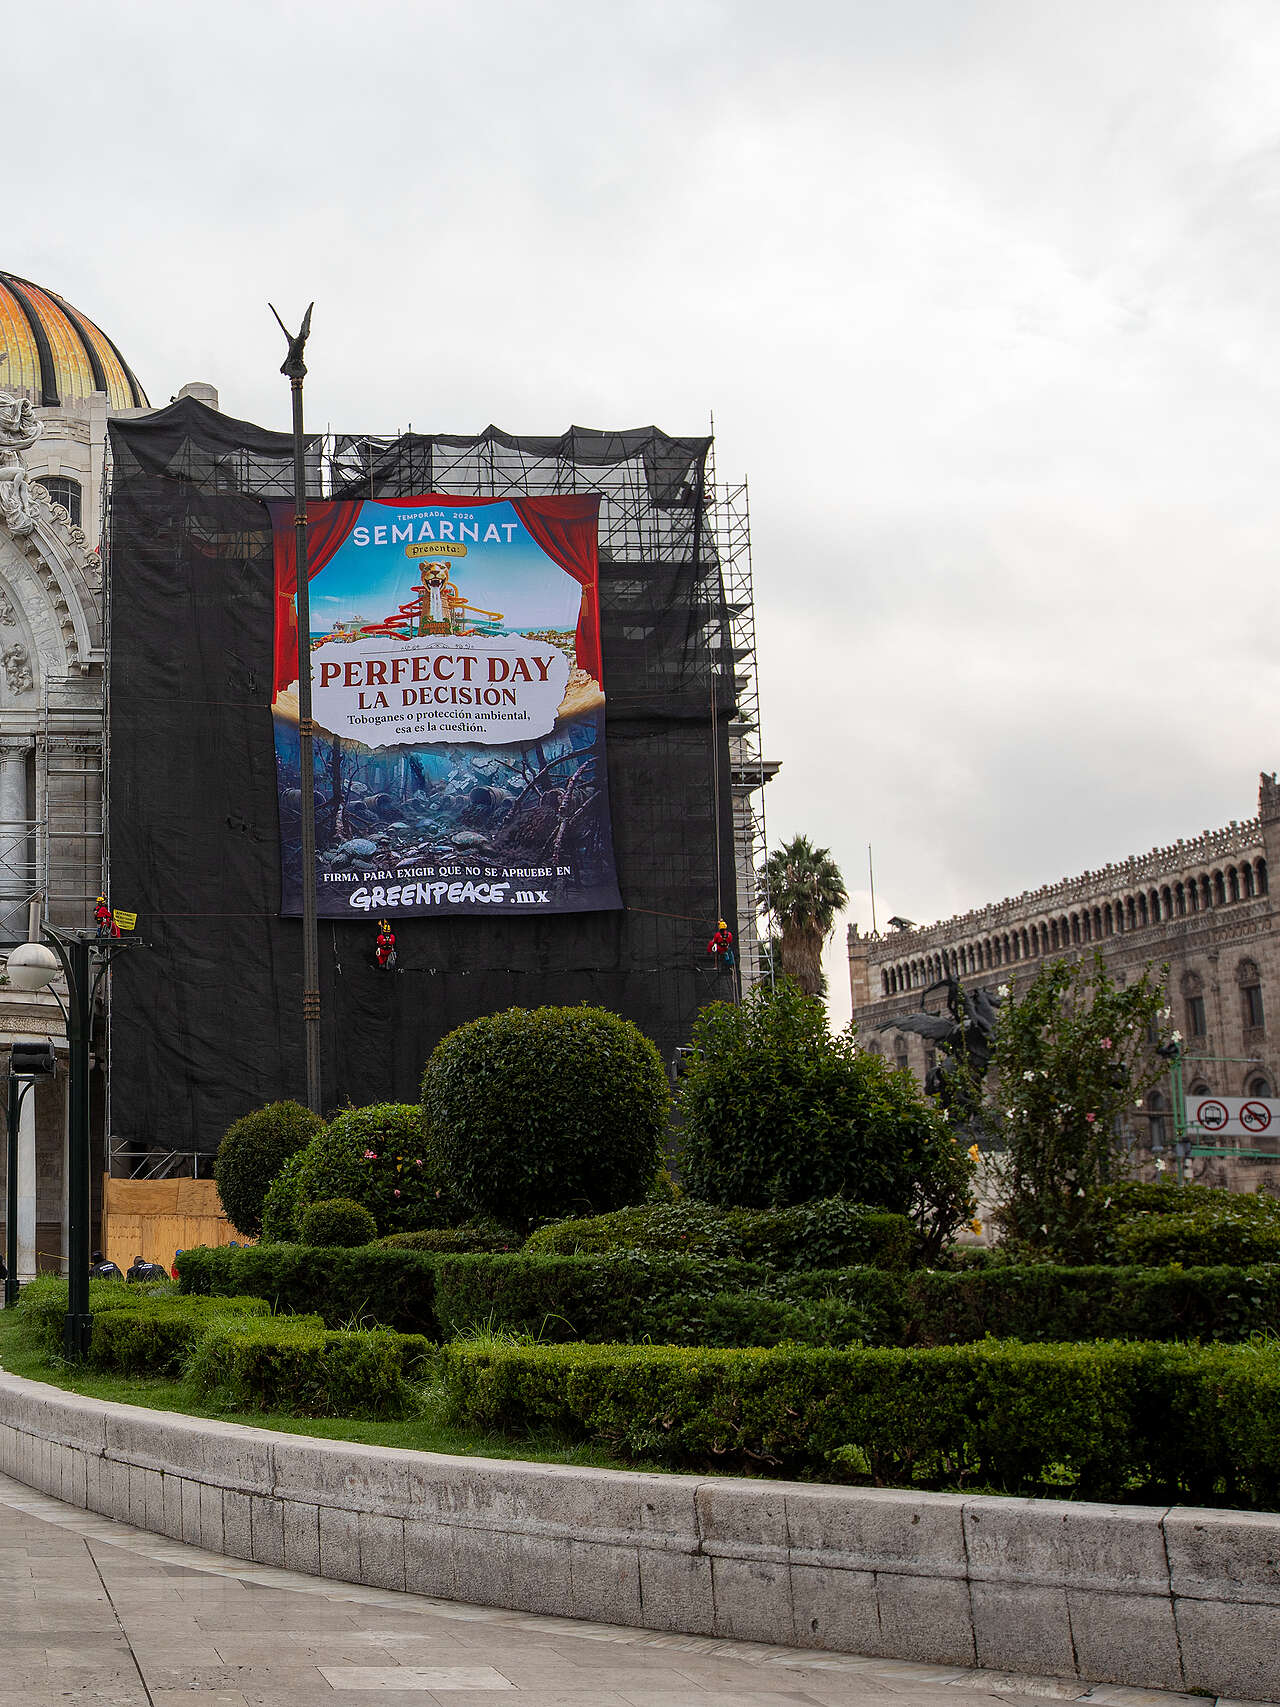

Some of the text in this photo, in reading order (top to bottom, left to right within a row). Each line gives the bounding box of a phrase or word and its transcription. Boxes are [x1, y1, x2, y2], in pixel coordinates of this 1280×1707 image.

[397, 512, 474, 521] TEMPORADA 2026
[353, 521, 518, 546] SEMARNAT
[320, 655, 555, 688] PERFECT DAY
[358, 683, 517, 710] LA DECISIÓN
[347, 713, 404, 725] Toboganes
[416, 709, 472, 722] protección
[474, 710, 531, 721] ambiental,
[395, 726, 412, 734] esa
[427, 722, 437, 731] la
[439, 722, 487, 732] cuestión.
[323, 866, 570, 882] FIRMA PARA EXIGIR QUE NO SE APRUEBE EN
